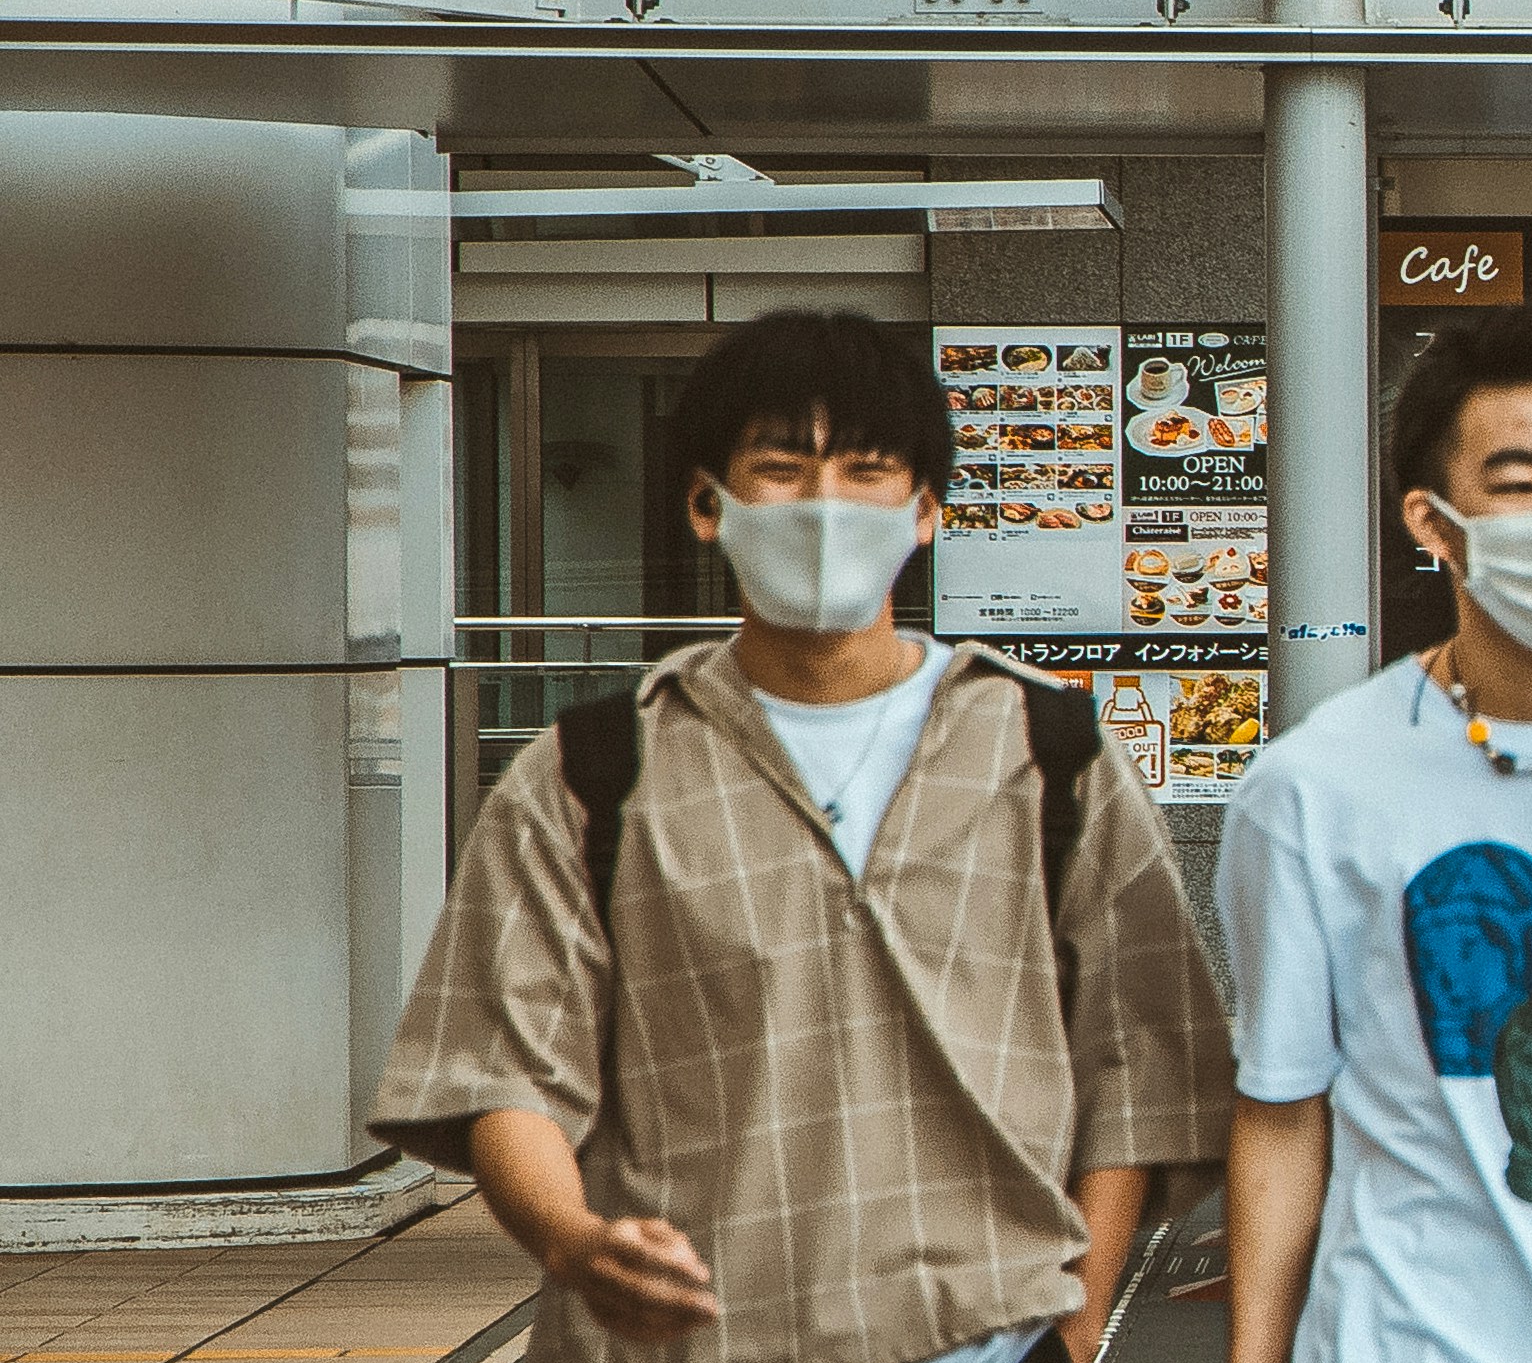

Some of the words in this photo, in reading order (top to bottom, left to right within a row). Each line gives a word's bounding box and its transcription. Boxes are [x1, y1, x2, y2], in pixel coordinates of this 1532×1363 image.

[1400, 244, 1499, 294] Cafe
[1183, 456, 1246, 474] OPEN
[1190, 512, 1222, 522] OPEN
[998, 643, 1121, 663] ストランフロア
[1133, 743, 1158, 753] OUT
